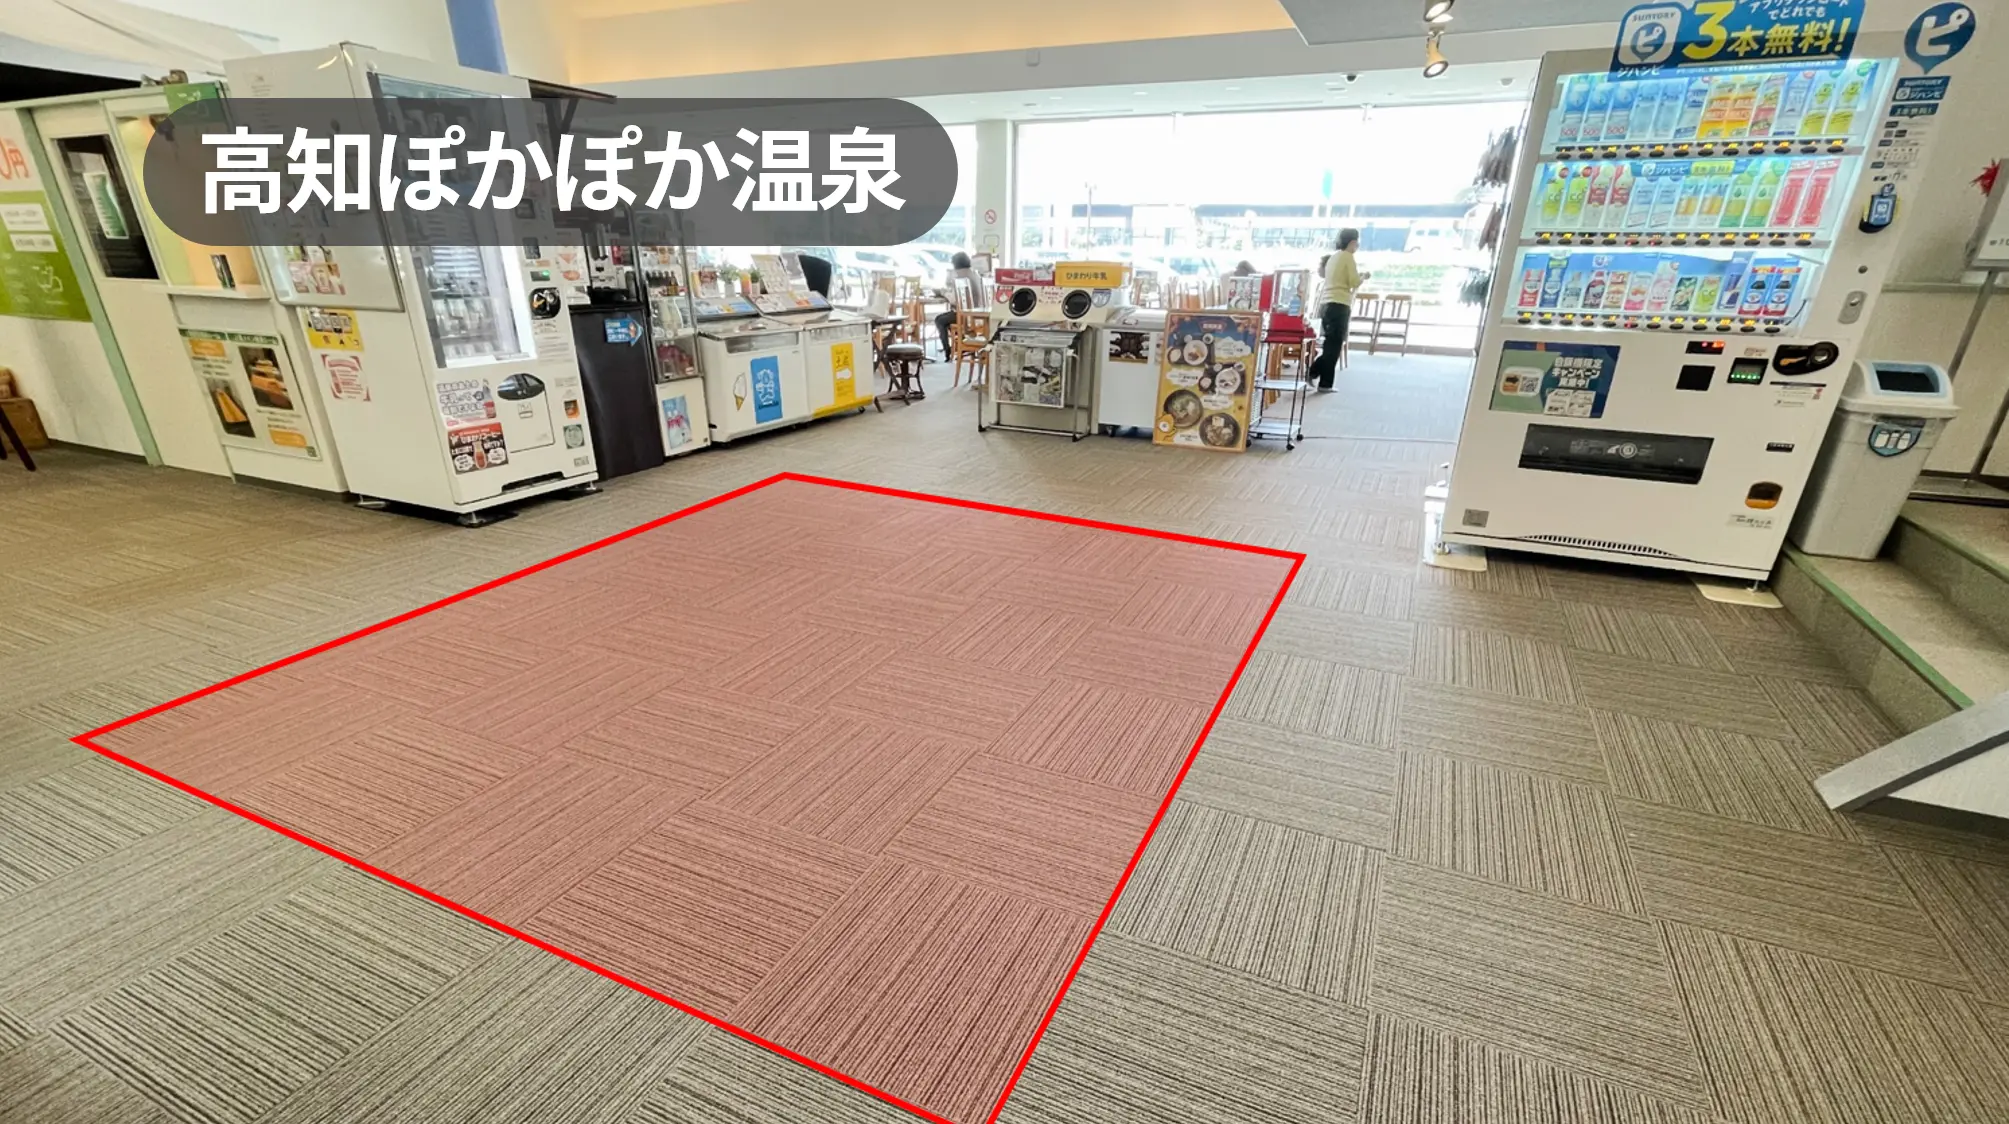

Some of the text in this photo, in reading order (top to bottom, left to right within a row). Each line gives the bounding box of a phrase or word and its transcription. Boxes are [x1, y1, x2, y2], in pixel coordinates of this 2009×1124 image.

[1632, 12, 1676, 22] SUNTORY
[1768, 6, 1826, 20] でどれでも
[1682, 1, 1851, 59] 3本無料!
[1065, 271, 1108, 281] ひまわり牛乳
[1554, 367, 1600, 379] キャンペーン
